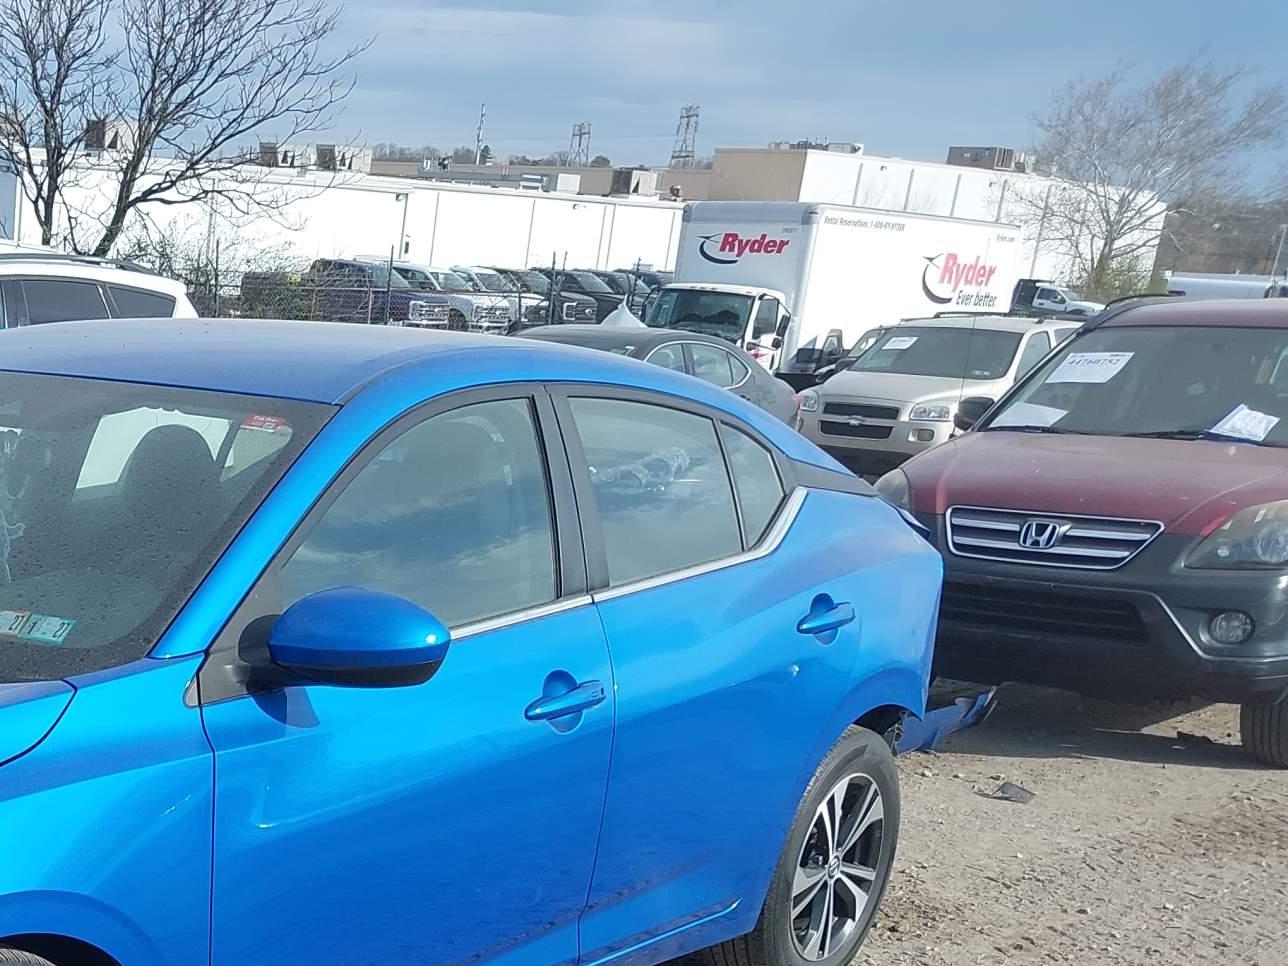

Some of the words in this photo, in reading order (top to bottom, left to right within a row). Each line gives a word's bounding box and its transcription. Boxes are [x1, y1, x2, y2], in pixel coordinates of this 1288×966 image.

[718, 233, 789, 257] Ryder
[939, 252, 997, 292] Ryder
[956, 290, 974, 306] Ever
[8, 614, 25, 632] 27
[53, 621, 71, 642] 27
